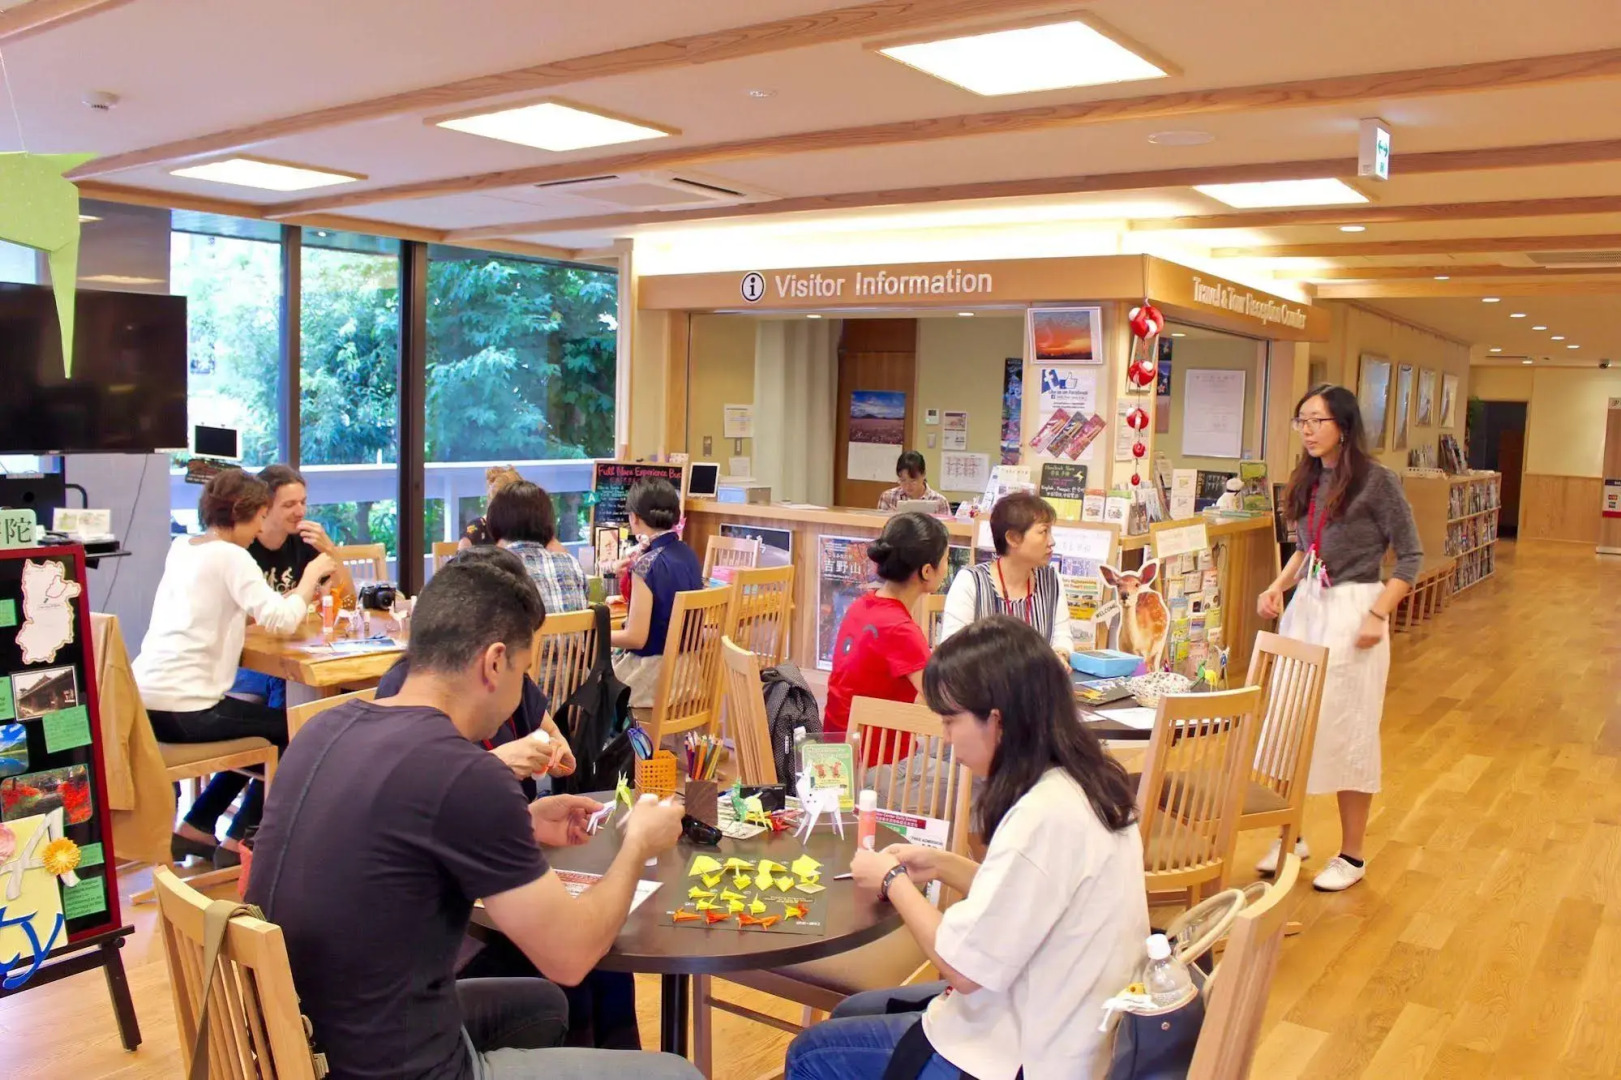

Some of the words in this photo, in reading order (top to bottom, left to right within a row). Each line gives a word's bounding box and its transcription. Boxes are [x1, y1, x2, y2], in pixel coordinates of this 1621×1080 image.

[775, 273, 846, 298] Visitor
[855, 269, 993, 296] Information
[1193, 276, 1221, 307] Travel
[1221, 289, 1228, 309] &
[1228, 286, 1246, 314] Tour
[1246, 293, 1281, 325] Reception
[1281, 304, 1307, 330] Counter
[597, 465, 614, 476] Full
[0, 517, 31, 545] 陀
[824, 559, 861, 575] 吉野山
